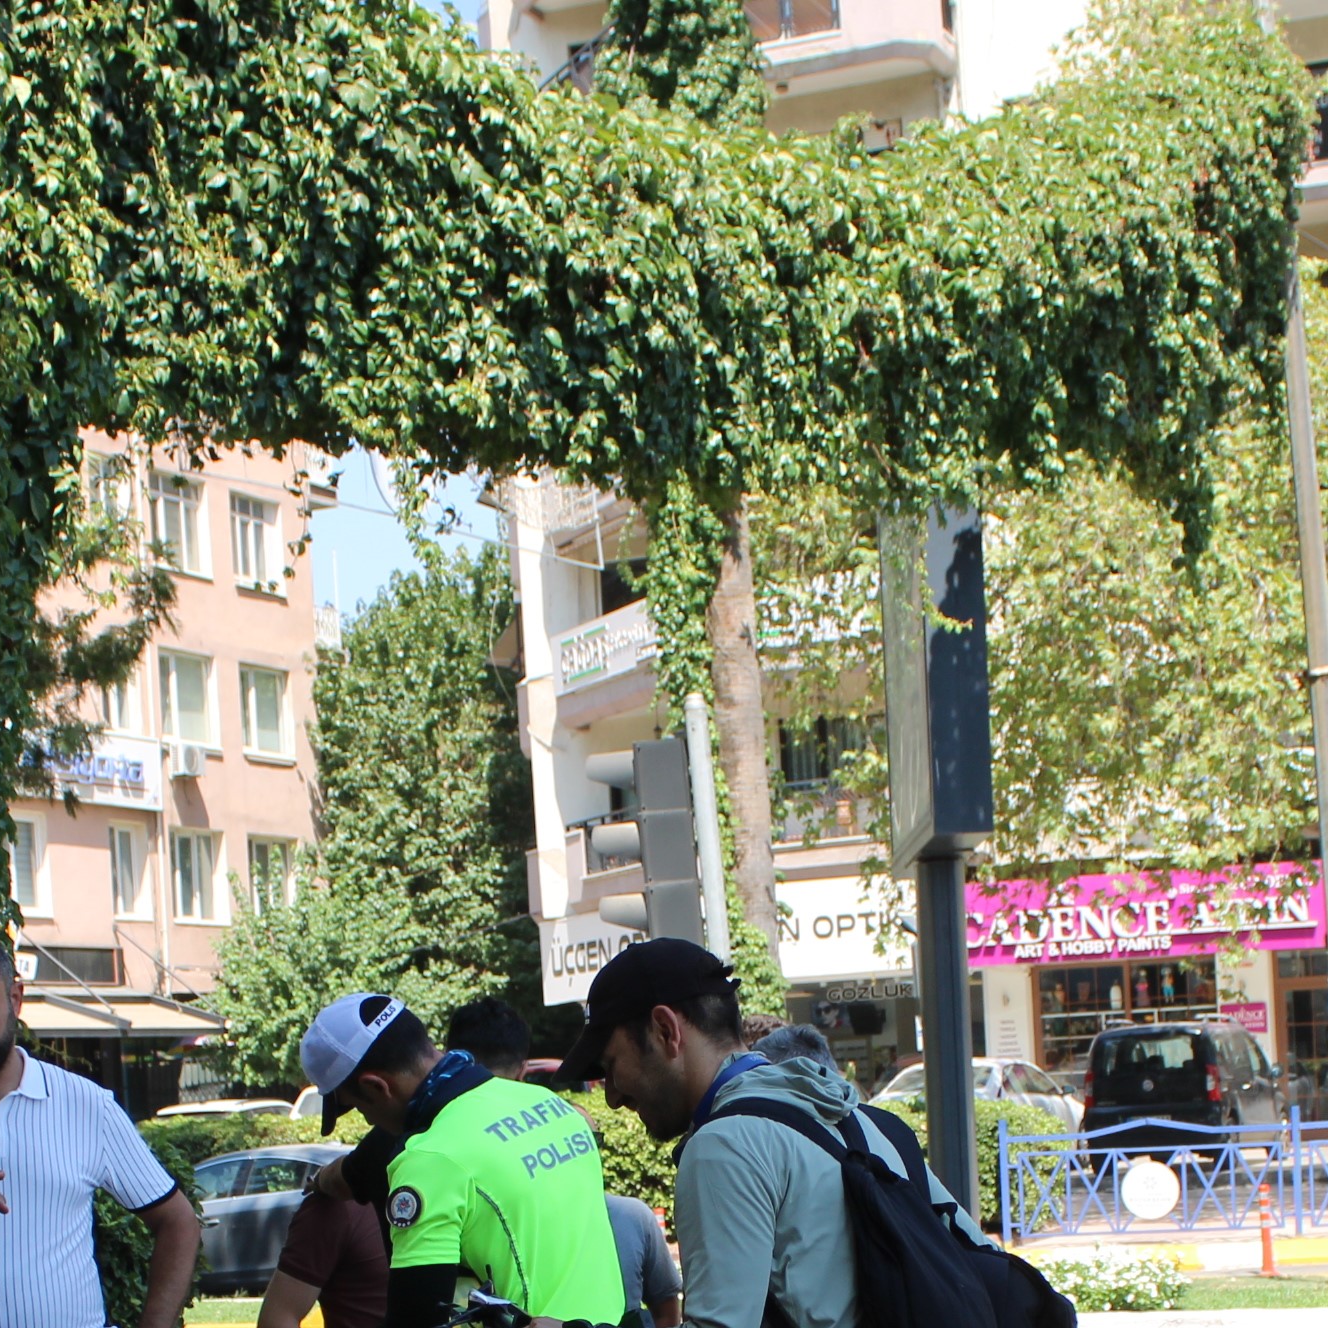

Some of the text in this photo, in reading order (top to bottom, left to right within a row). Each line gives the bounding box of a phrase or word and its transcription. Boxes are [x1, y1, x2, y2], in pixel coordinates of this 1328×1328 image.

[966, 900, 1172, 948] CADENCE
[1014, 936, 1172, 959] ART & HOBBY PAINTS
[551, 936, 612, 987] ÜÇGEN
